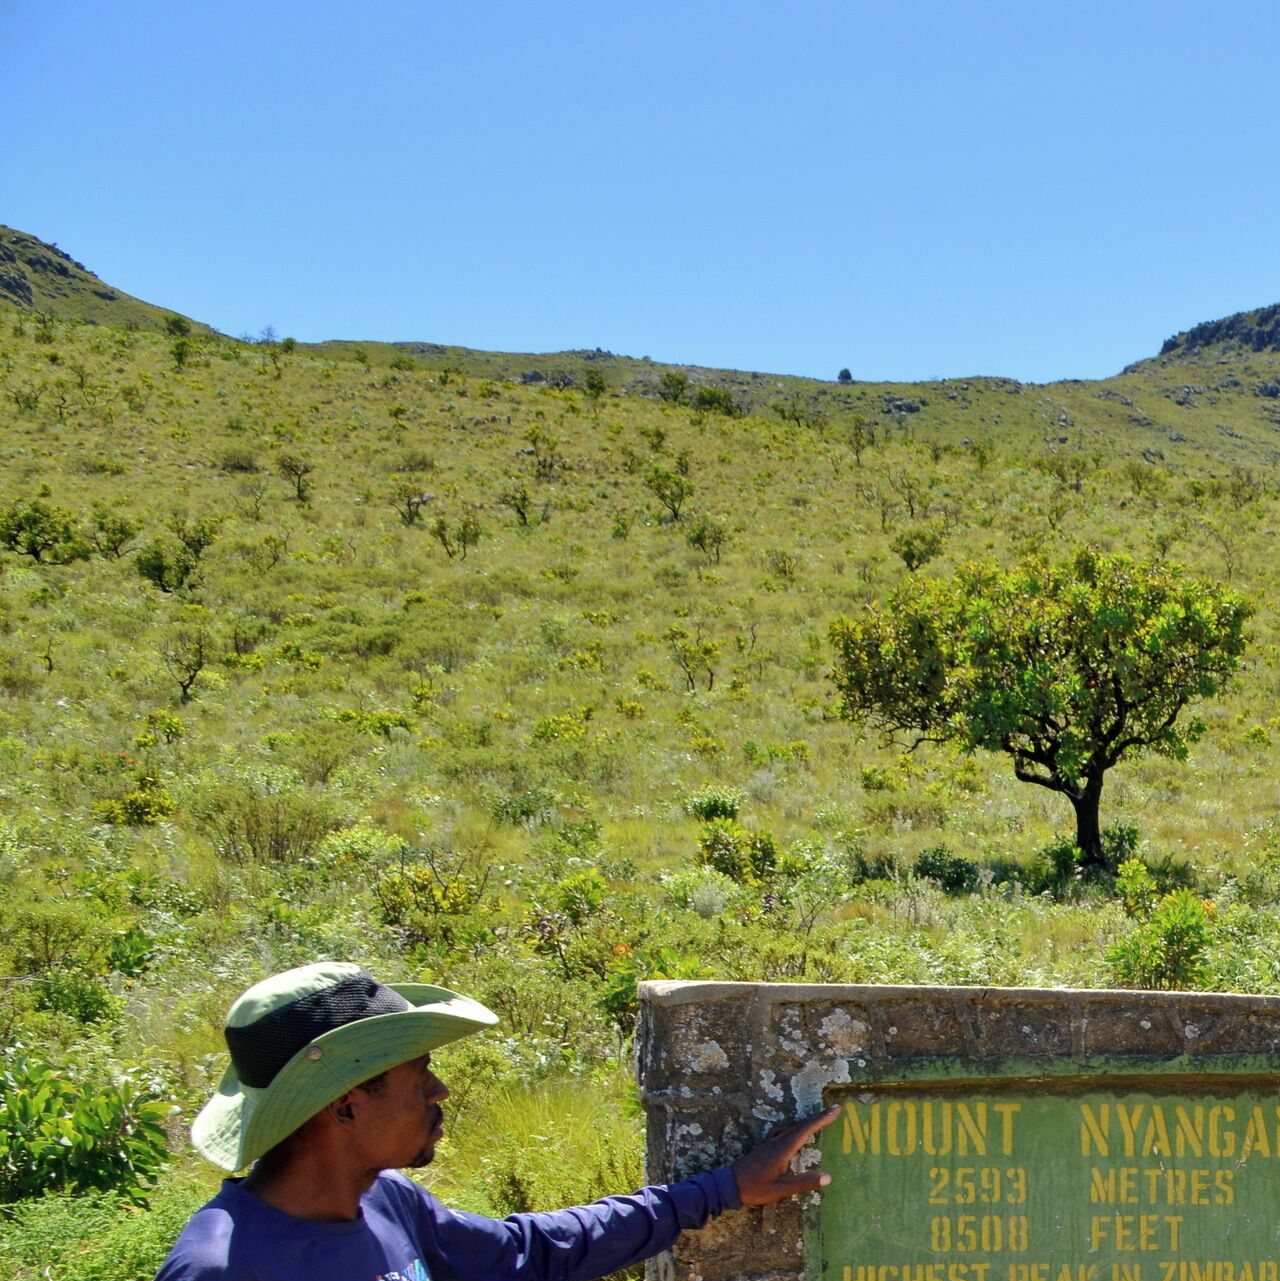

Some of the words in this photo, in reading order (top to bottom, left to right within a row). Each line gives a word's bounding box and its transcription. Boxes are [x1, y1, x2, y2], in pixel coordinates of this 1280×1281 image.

[843, 1101, 1021, 1157] MOUNT
[929, 1167, 1026, 1204] 2593
[1090, 1167, 1234, 1205] METRES
[931, 1215, 1029, 1254] 8508
[1091, 1214, 1184, 1253] FEET
[384, 1271, 400, 1281] TCS
